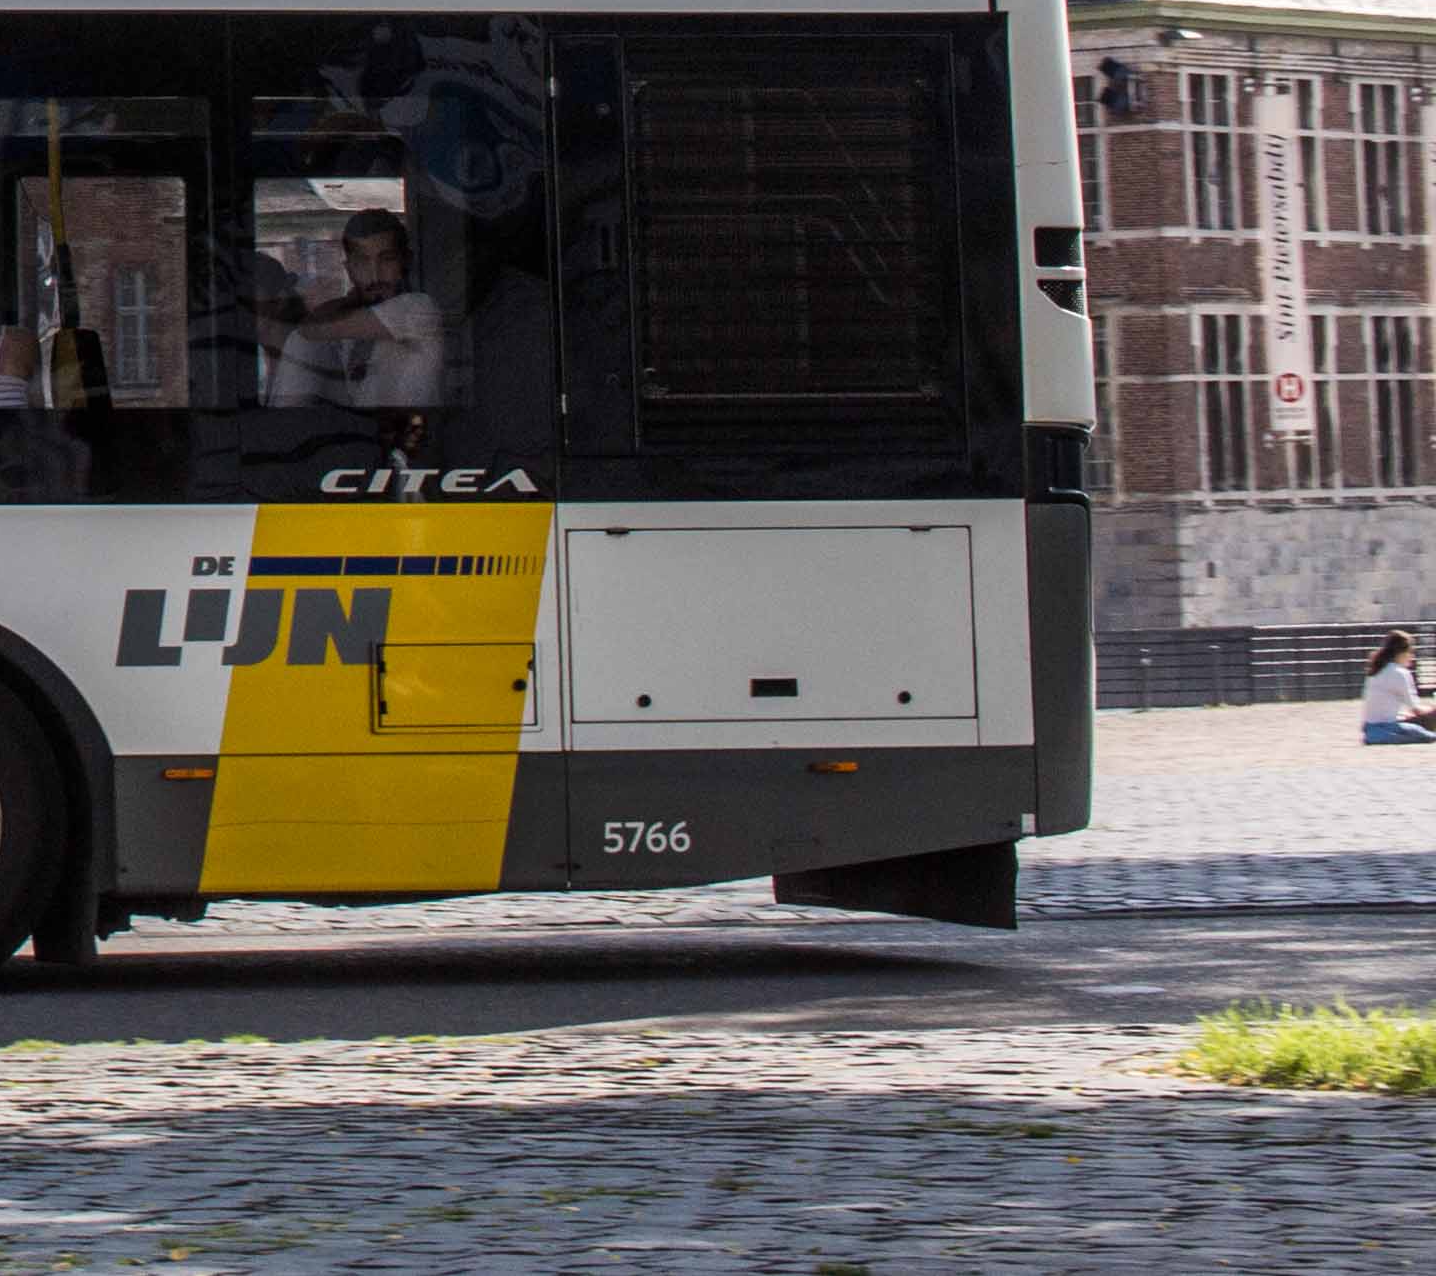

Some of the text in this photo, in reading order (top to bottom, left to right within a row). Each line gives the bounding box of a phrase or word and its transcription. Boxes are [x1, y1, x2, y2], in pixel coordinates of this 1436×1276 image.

[319, 469, 539, 493] CITEA
[192, 556, 235, 576] DE
[115, 588, 393, 667] LIJN
[603, 821, 691, 853] 5766
